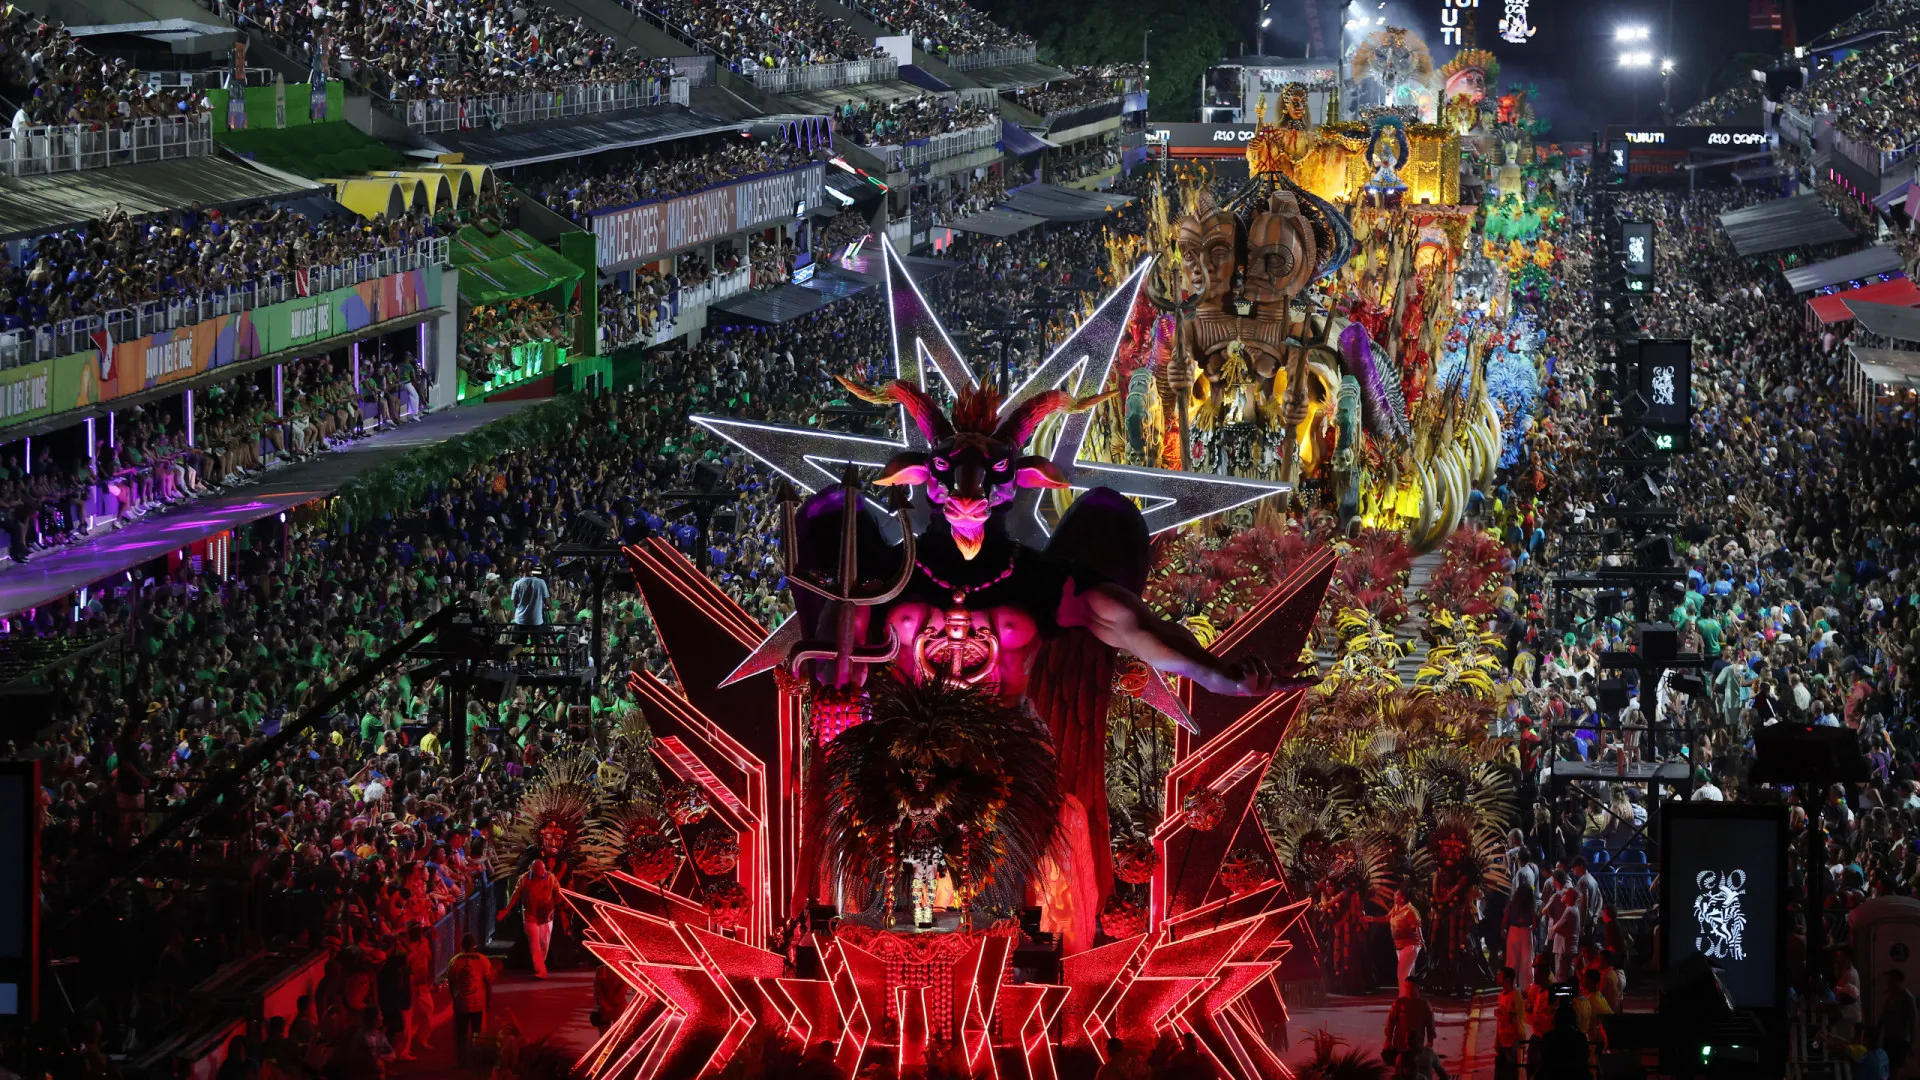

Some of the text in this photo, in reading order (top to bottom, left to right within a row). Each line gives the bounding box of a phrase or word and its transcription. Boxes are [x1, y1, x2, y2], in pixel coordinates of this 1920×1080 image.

[1625, 132, 1665, 143] TUIUTI
[666, 189, 729, 250] MAR DE SONHOS
[736, 174, 795, 230] MAR DE SORRISOS
[593, 205, 659, 268] MAR DE CORES
